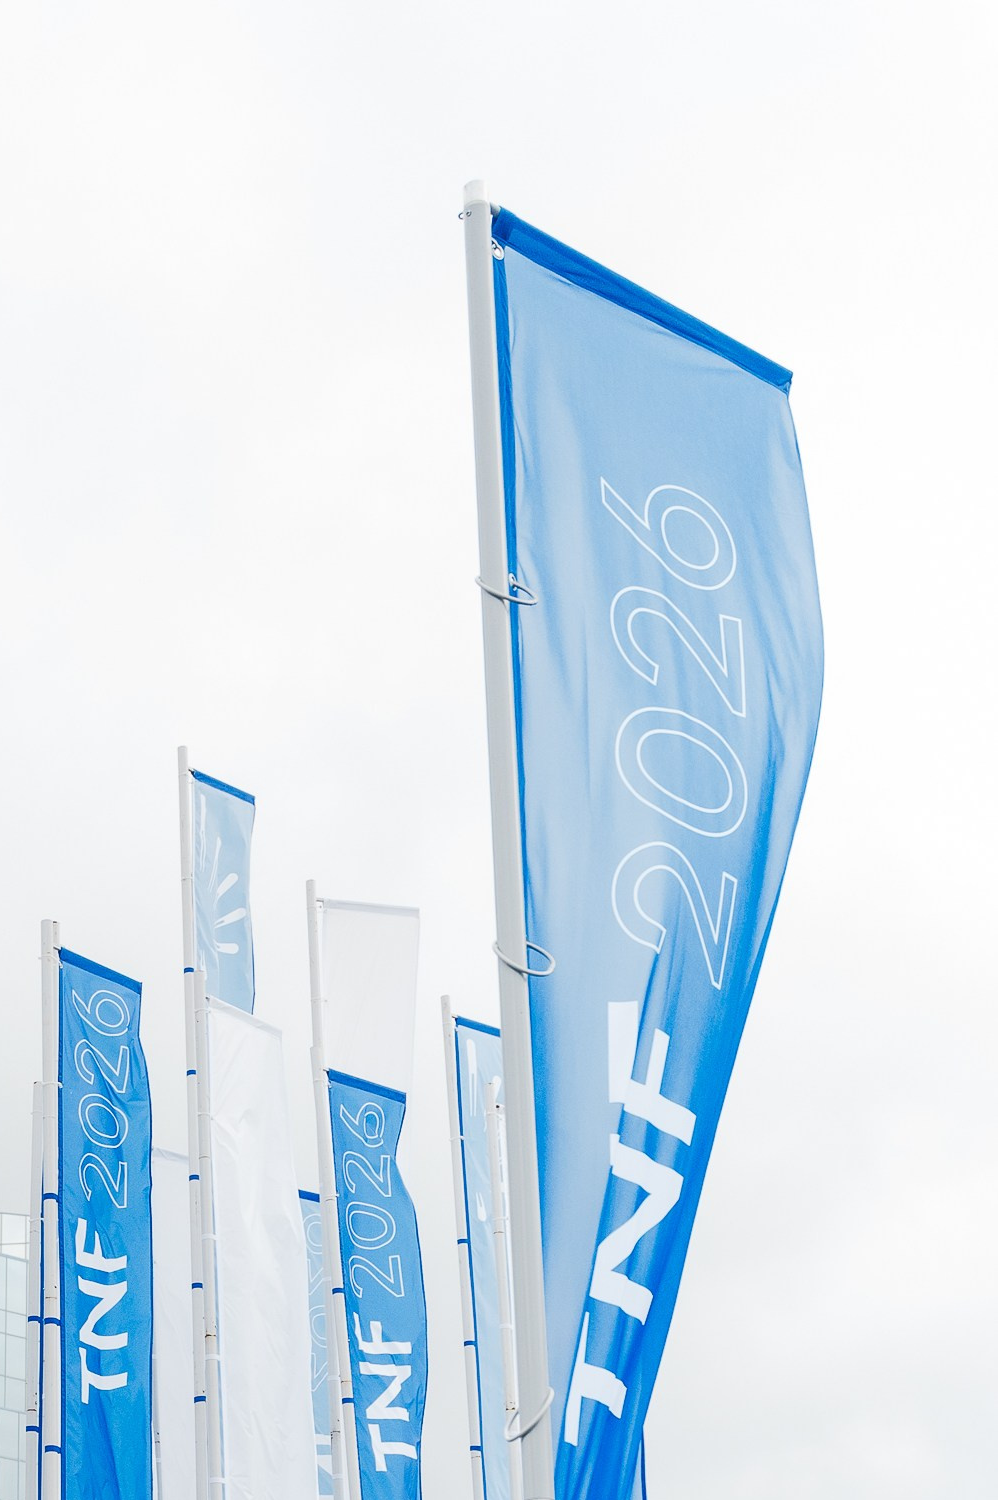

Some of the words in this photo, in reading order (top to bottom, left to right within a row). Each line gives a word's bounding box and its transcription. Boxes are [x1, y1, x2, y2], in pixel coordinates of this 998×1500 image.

[601, 478, 748, 989] 2026
[72, 988, 131, 1209] 2026
[339, 1101, 406, 1299] 2026
[74, 1216, 129, 1405] TNF
[564, 1000, 697, 1447] TNF
[352, 1311, 419, 1473] TNF
